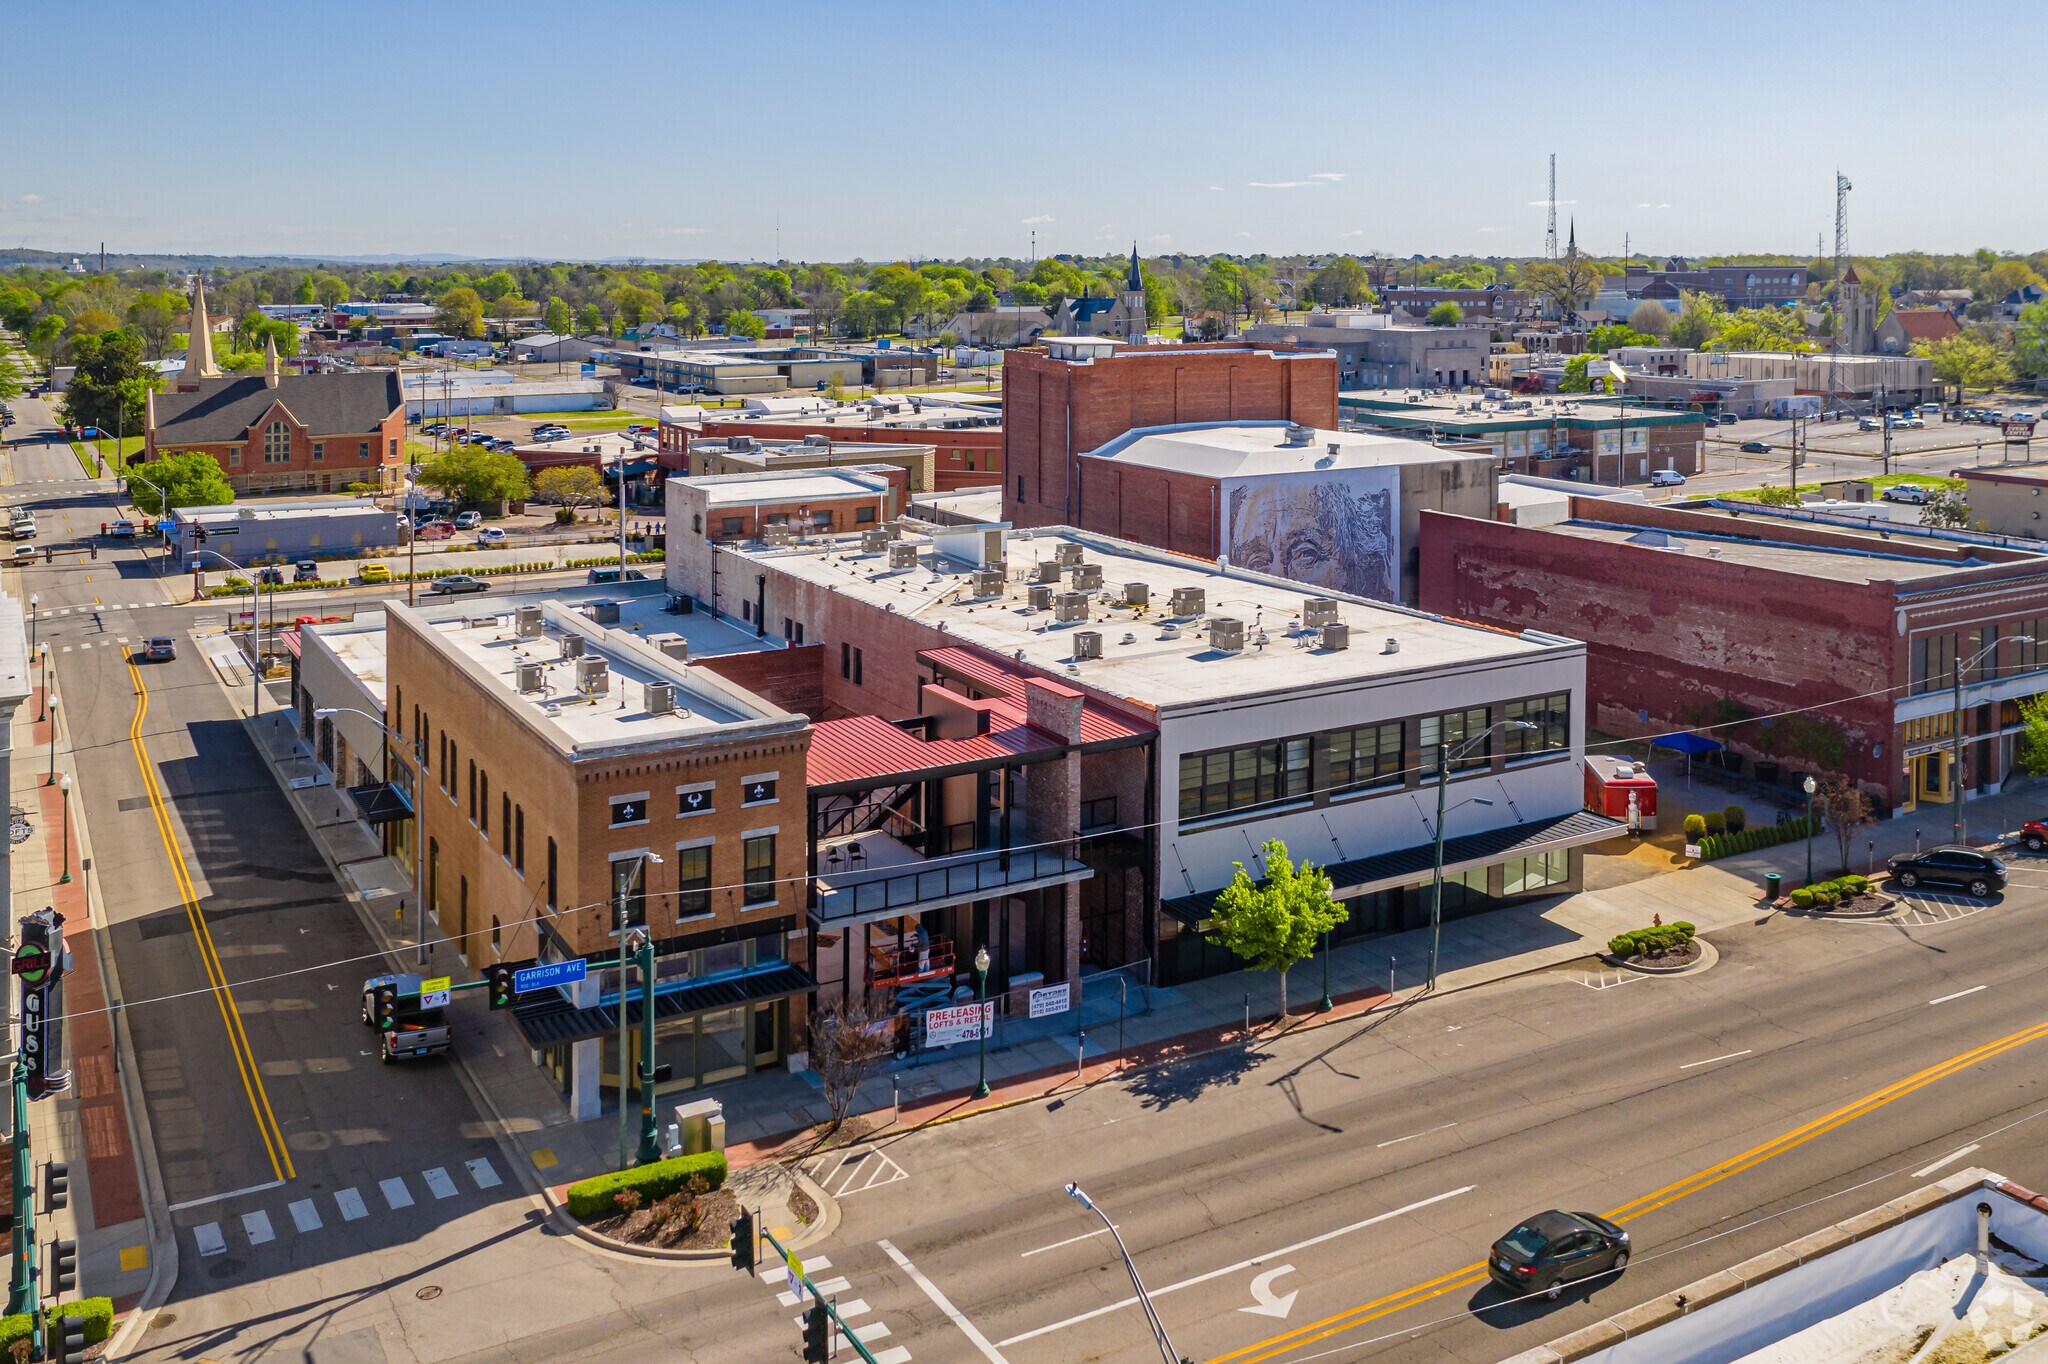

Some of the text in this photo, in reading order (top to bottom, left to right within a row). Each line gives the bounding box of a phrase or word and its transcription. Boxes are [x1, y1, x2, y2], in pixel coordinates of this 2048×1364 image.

[9, 827, 34, 836] OFTS
[13, 957, 48, 973] GRILL
[520, 962, 582, 982] GARRISON AVE
[929, 1004, 991, 1022] PRE-LEASING
[929, 1014, 991, 1030] LOFTS & RETAIL
